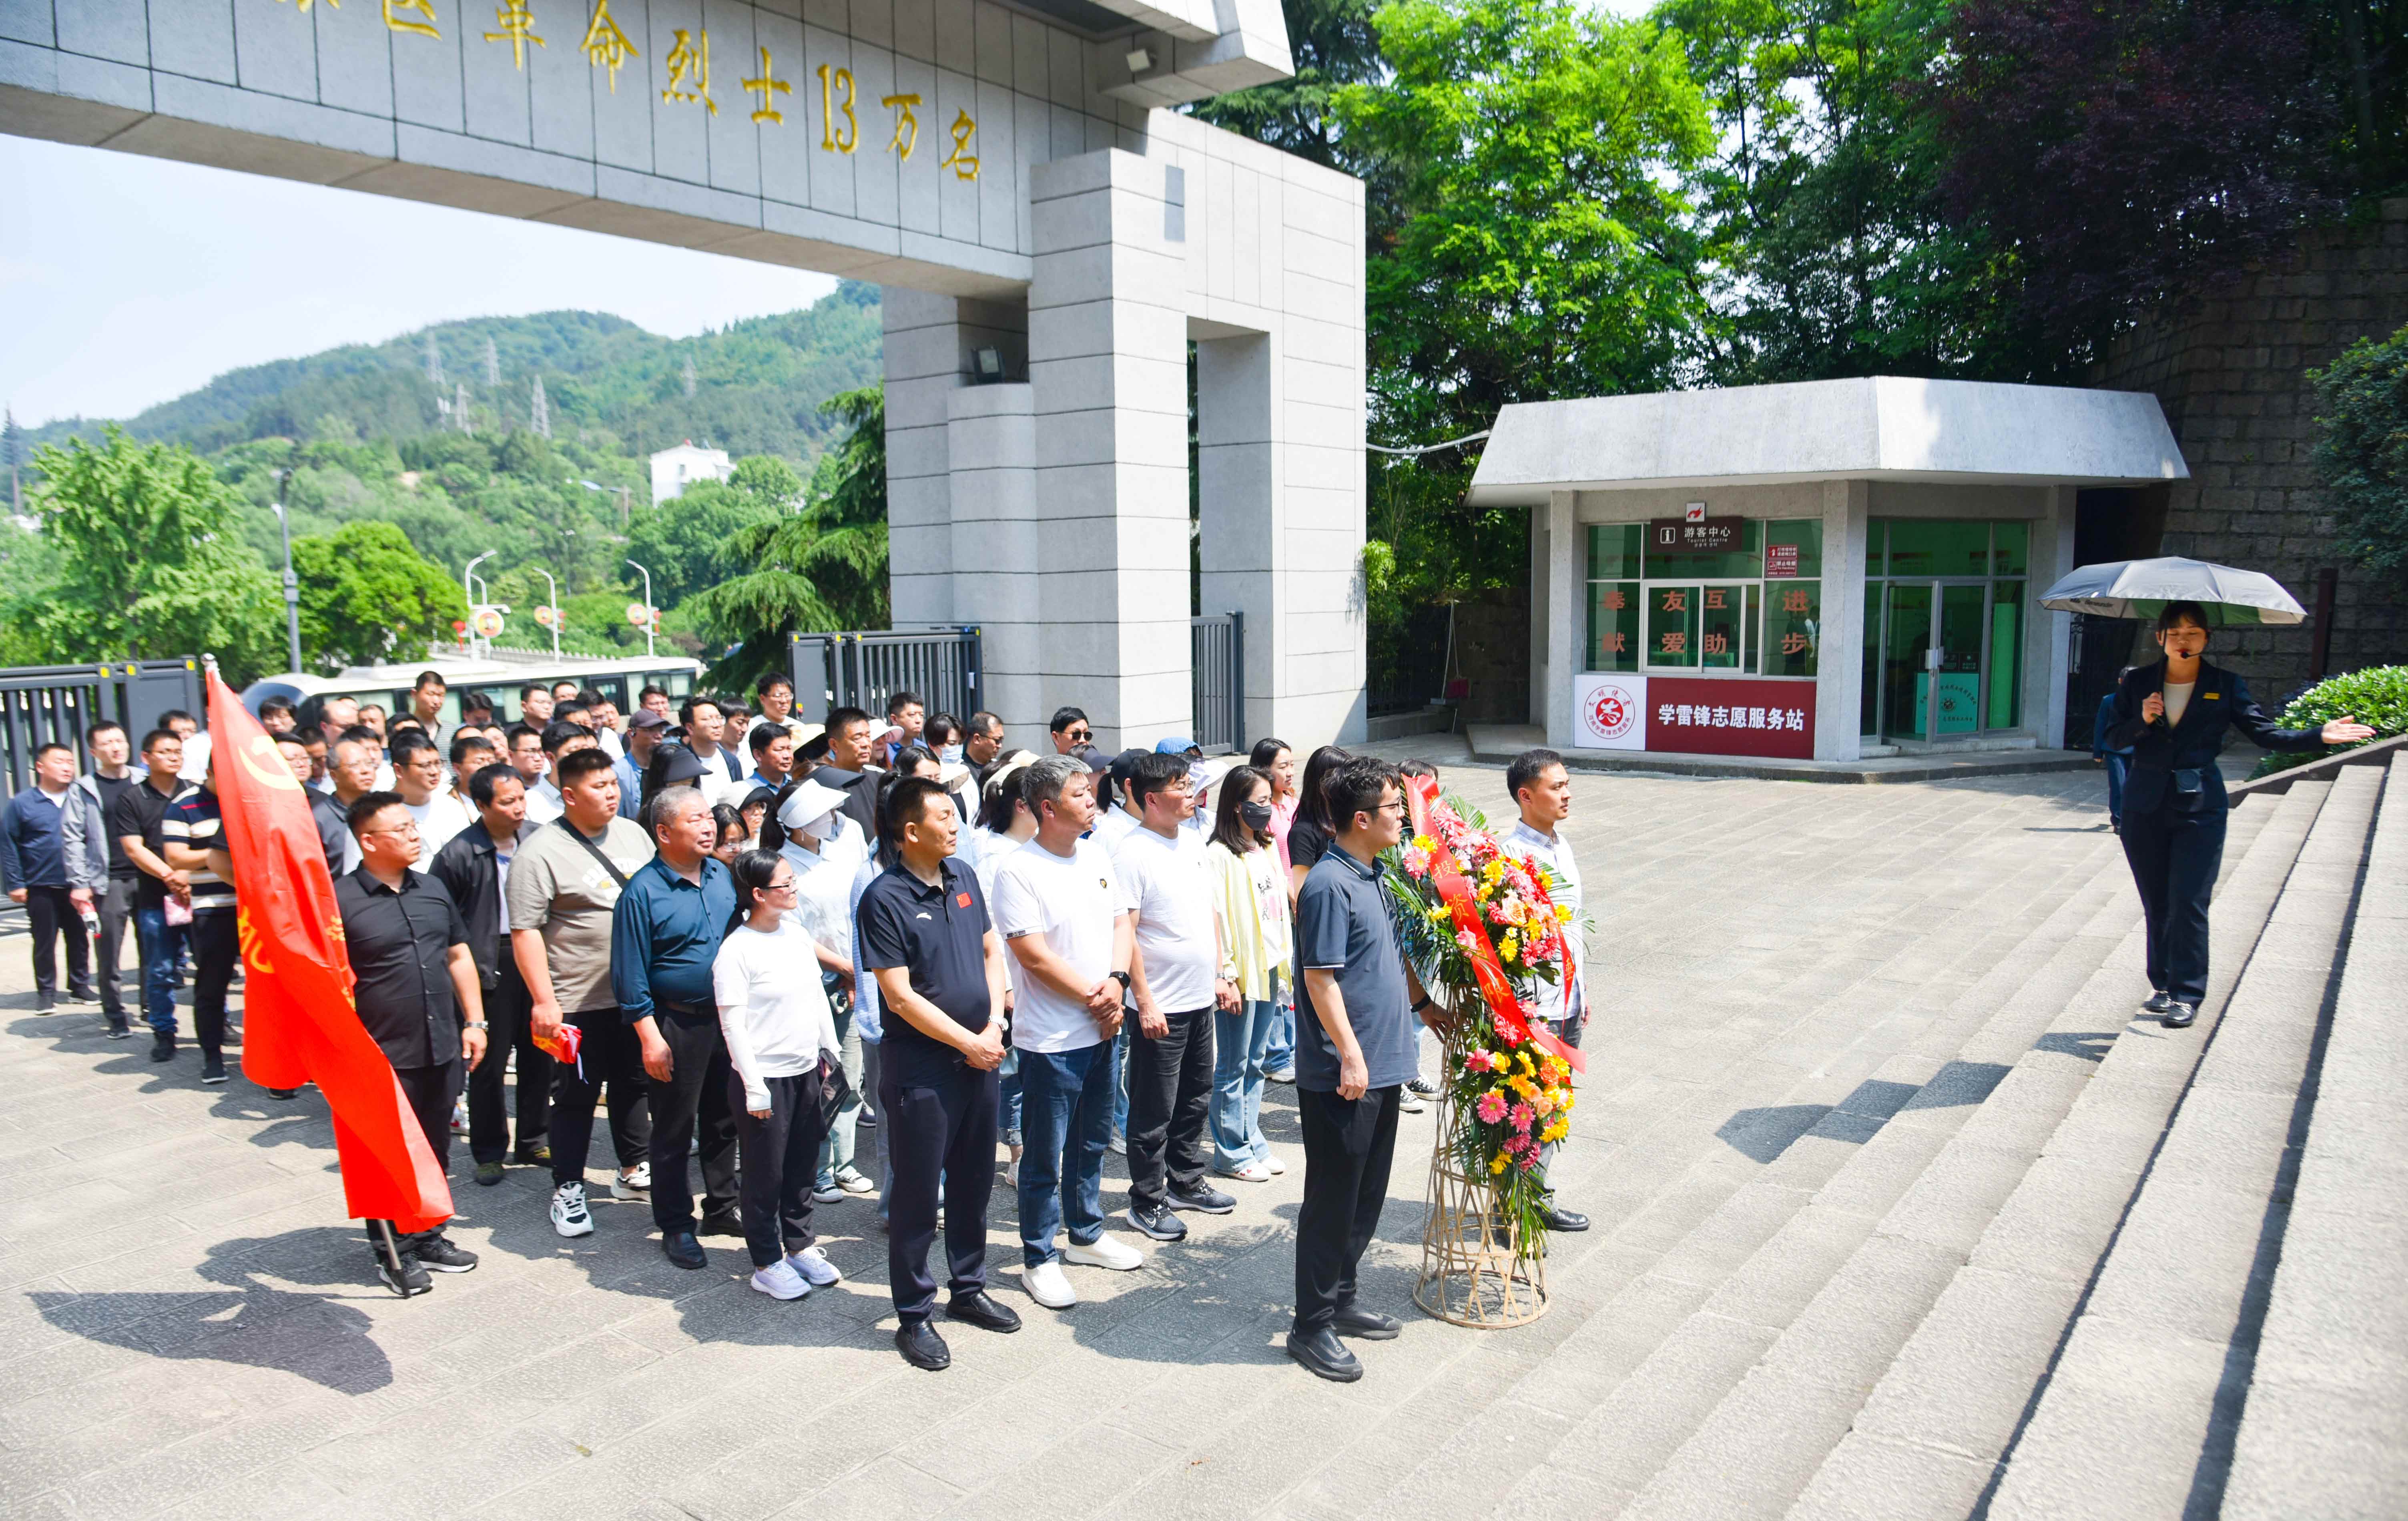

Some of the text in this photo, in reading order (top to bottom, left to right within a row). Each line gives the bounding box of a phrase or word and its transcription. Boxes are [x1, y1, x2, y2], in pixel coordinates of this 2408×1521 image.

[275, 0, 981, 182] 区革命烈士13万名
[1684, 526, 1730, 538] 游客中心
[1662, 590, 1687, 653] 友爱
[1704, 590, 1727, 654] 互助
[1781, 590, 1809, 655] 进步
[1658, 704, 1804, 731] 学雷锋志愿服务站
